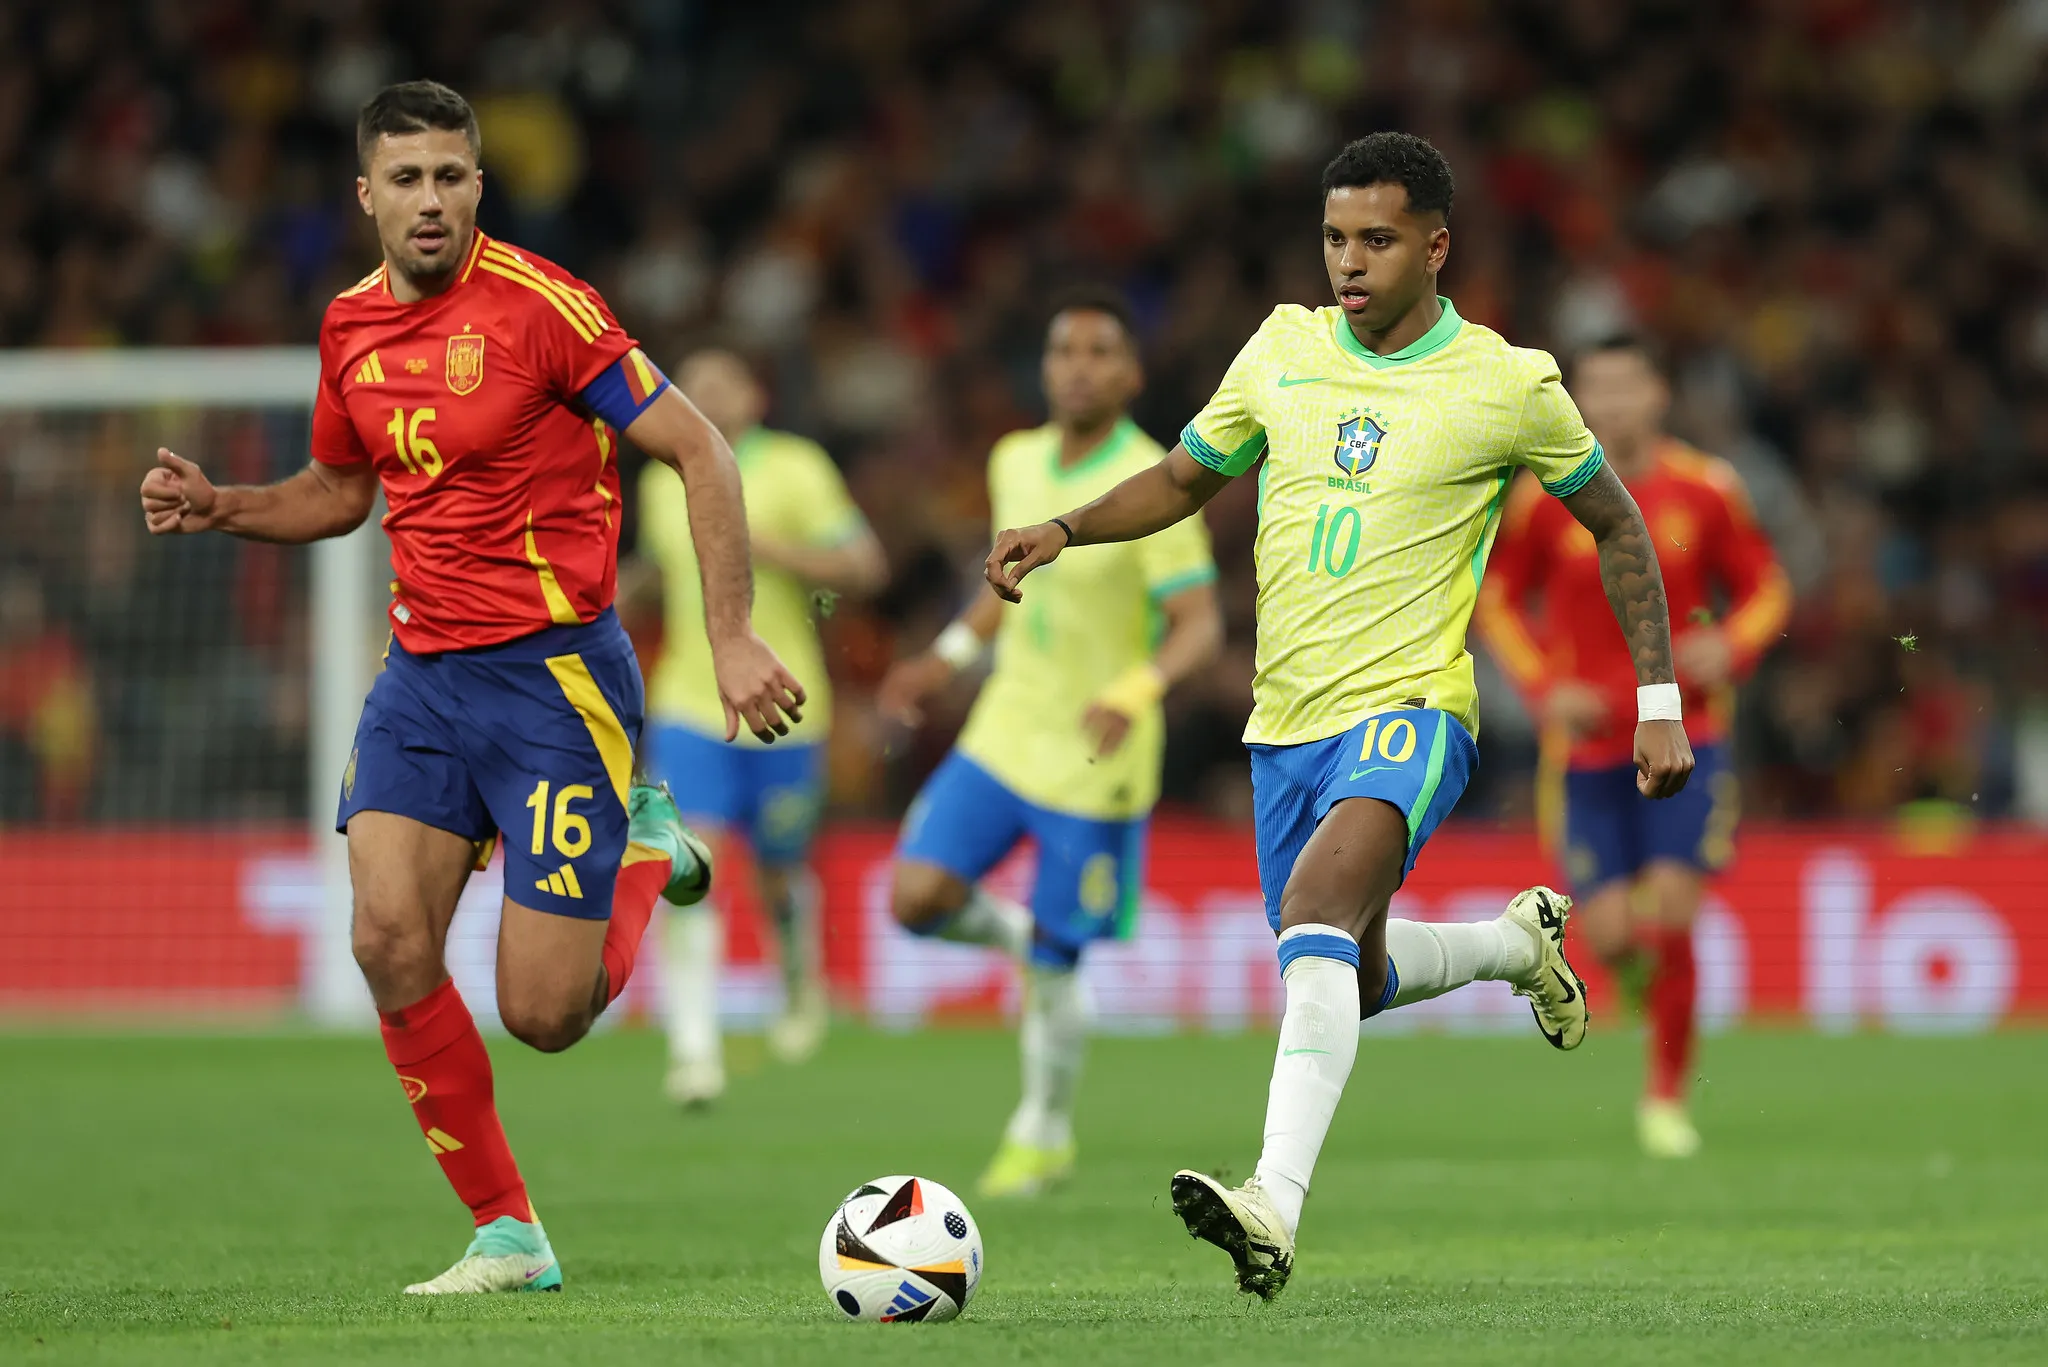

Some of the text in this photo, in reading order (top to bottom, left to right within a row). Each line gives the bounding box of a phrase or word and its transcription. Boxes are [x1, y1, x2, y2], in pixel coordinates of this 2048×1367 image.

[387, 407, 443, 478] 16
[1349, 439, 1368, 449] CBF
[1327, 476, 1373, 494] BRASIL
[1308, 503, 1361, 579] 10
[1359, 718, 1417, 763] 10
[526, 780, 594, 858] 16
